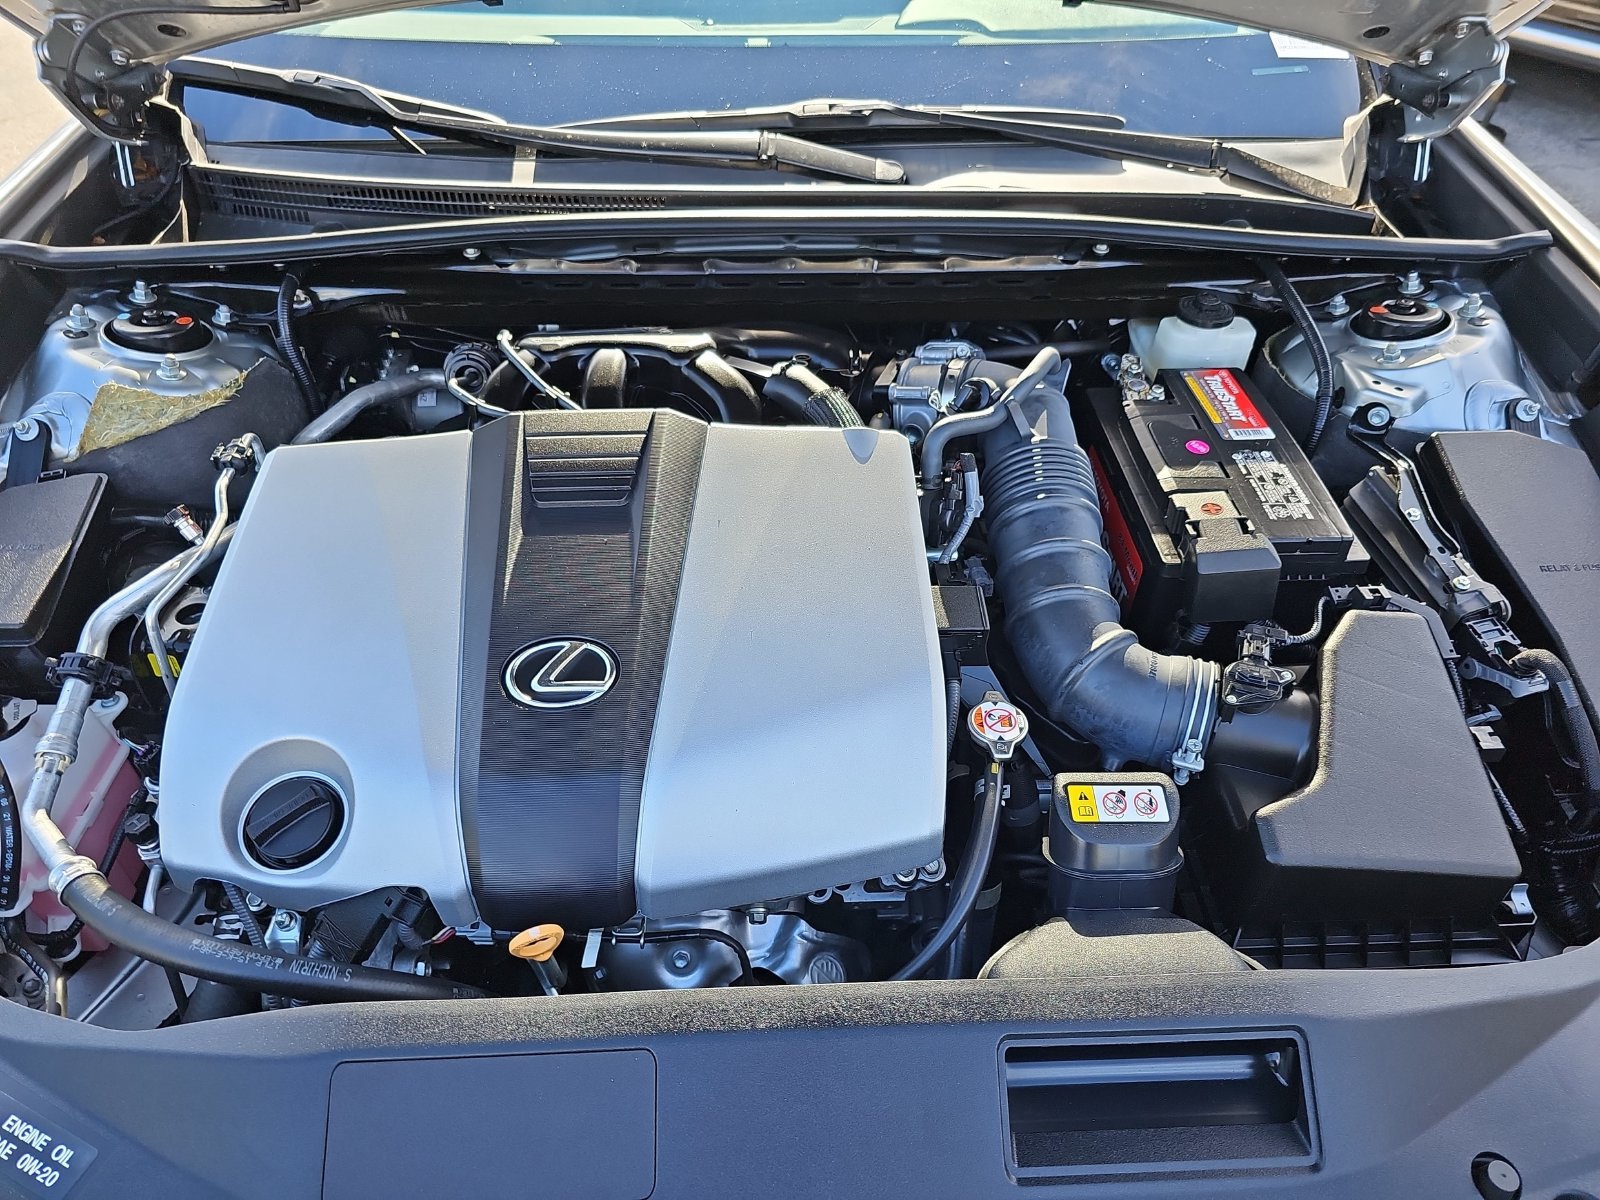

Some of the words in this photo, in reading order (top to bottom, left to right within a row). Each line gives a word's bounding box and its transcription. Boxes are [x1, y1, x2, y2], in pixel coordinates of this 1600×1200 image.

[1538, 564, 1571, 573] RELAY
[1, 1114, 52, 1152] ENGINE
[51, 1144, 75, 1169] OIL
[16, 1153, 60, 1187] 0W-20
